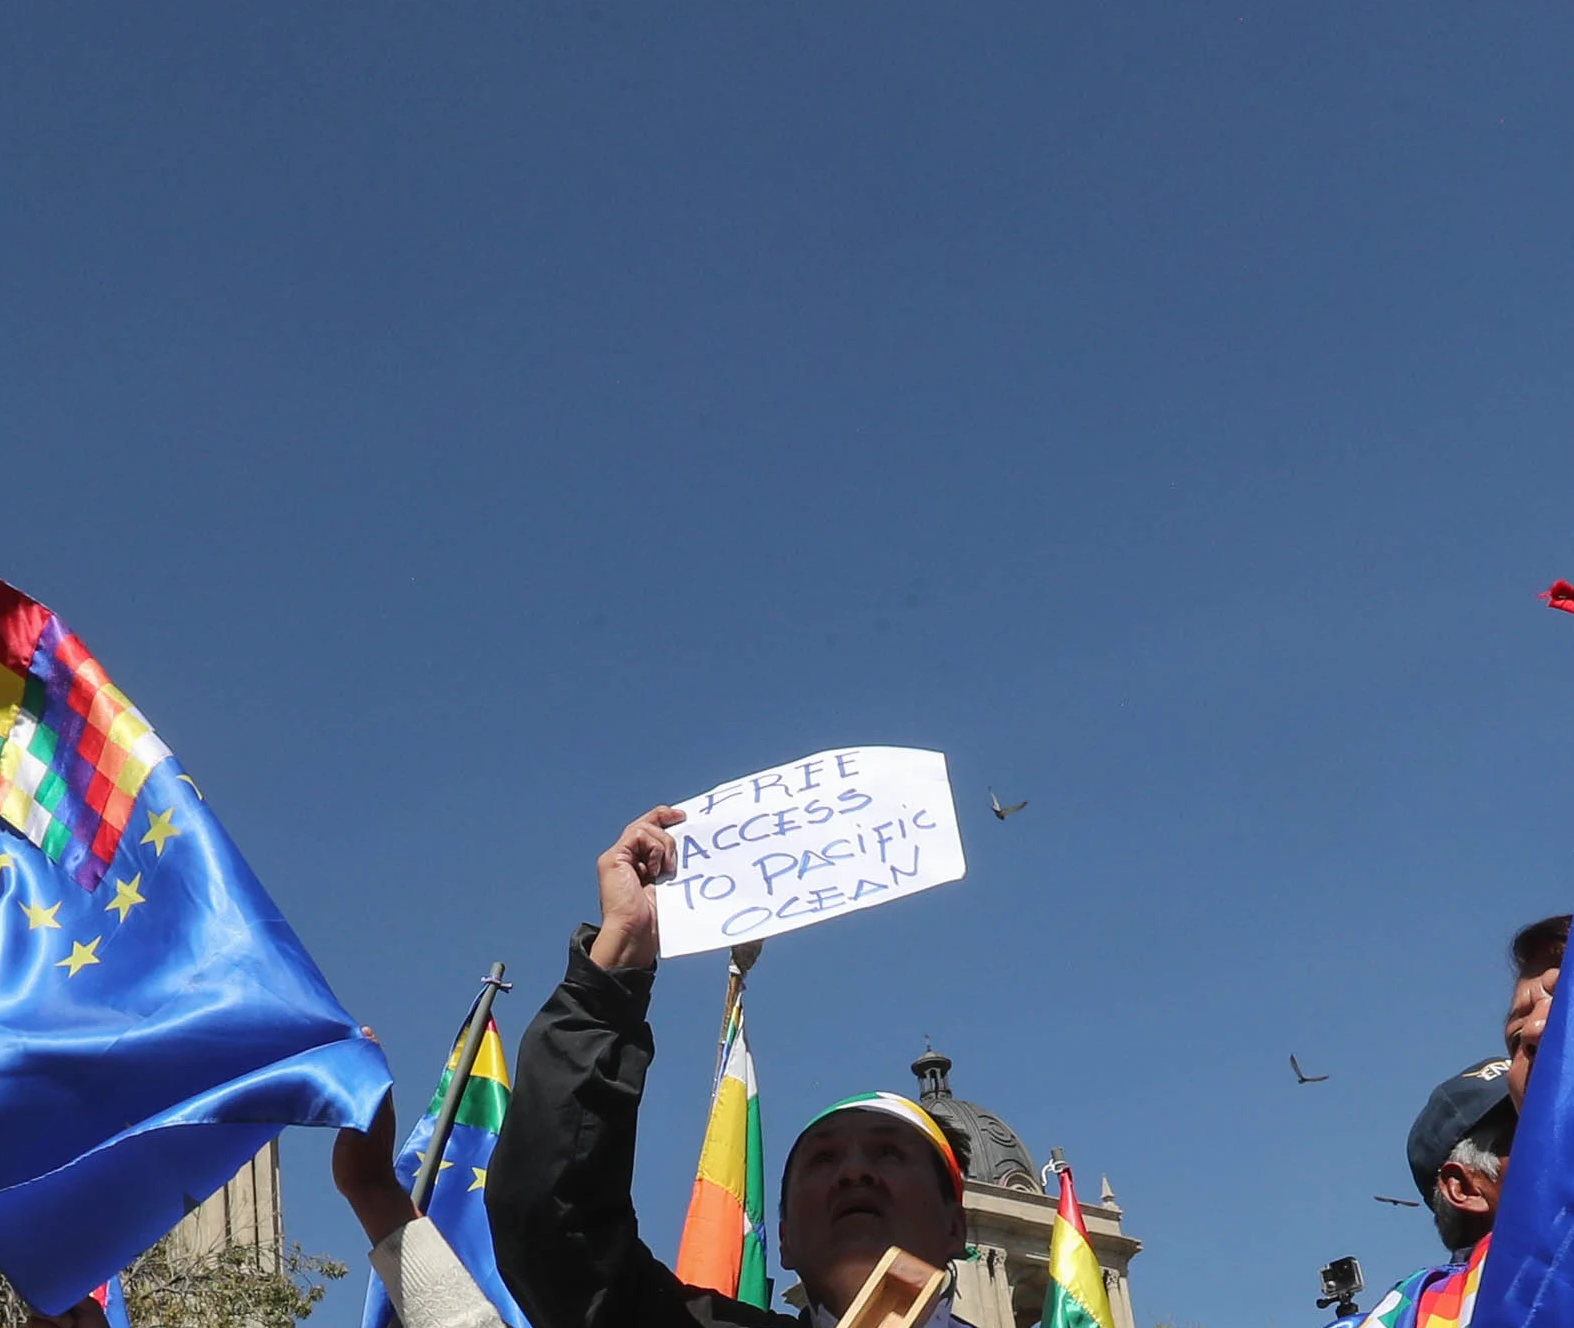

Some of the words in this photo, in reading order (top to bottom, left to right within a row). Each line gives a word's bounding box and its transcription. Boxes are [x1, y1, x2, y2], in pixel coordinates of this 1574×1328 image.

[699, 751, 860, 814] FREE
[681, 788, 872, 869] ACCESS
[666, 873, 736, 910] TO
[721, 845, 920, 937] OCEAN
